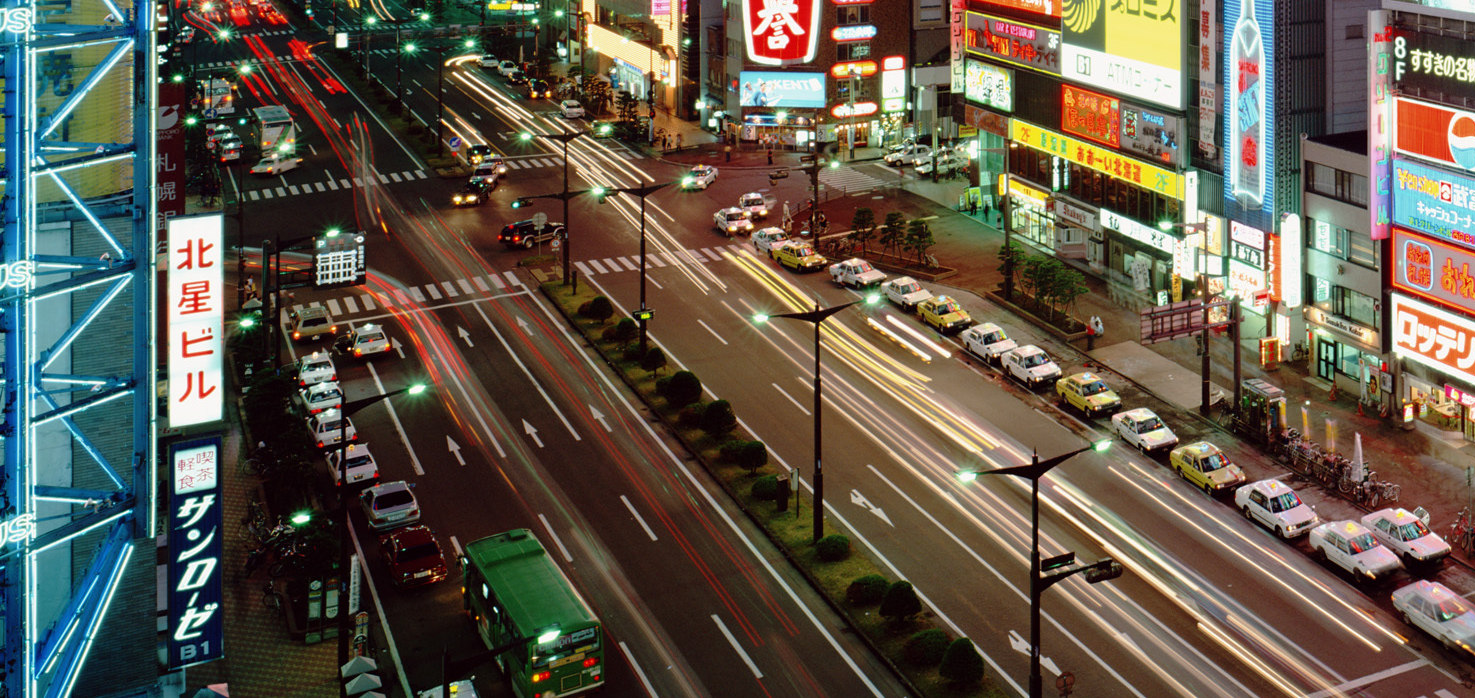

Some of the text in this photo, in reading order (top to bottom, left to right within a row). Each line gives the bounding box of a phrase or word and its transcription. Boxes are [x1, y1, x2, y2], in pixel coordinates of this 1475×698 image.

[1047, 32, 1060, 49] 3F
[1077, 54, 1091, 76] B1
[774, 78, 810, 91] KENT
[1375, 53, 1390, 226] グリーンビル
[1154, 172, 1170, 192] 2F
[177, 238, 216, 402] 北星ビル
[177, 457, 195, 491] 軽食
[196, 450, 214, 482] 喫茶
[174, 494, 218, 641] サンローゼ
[180, 641, 210, 660] B1
